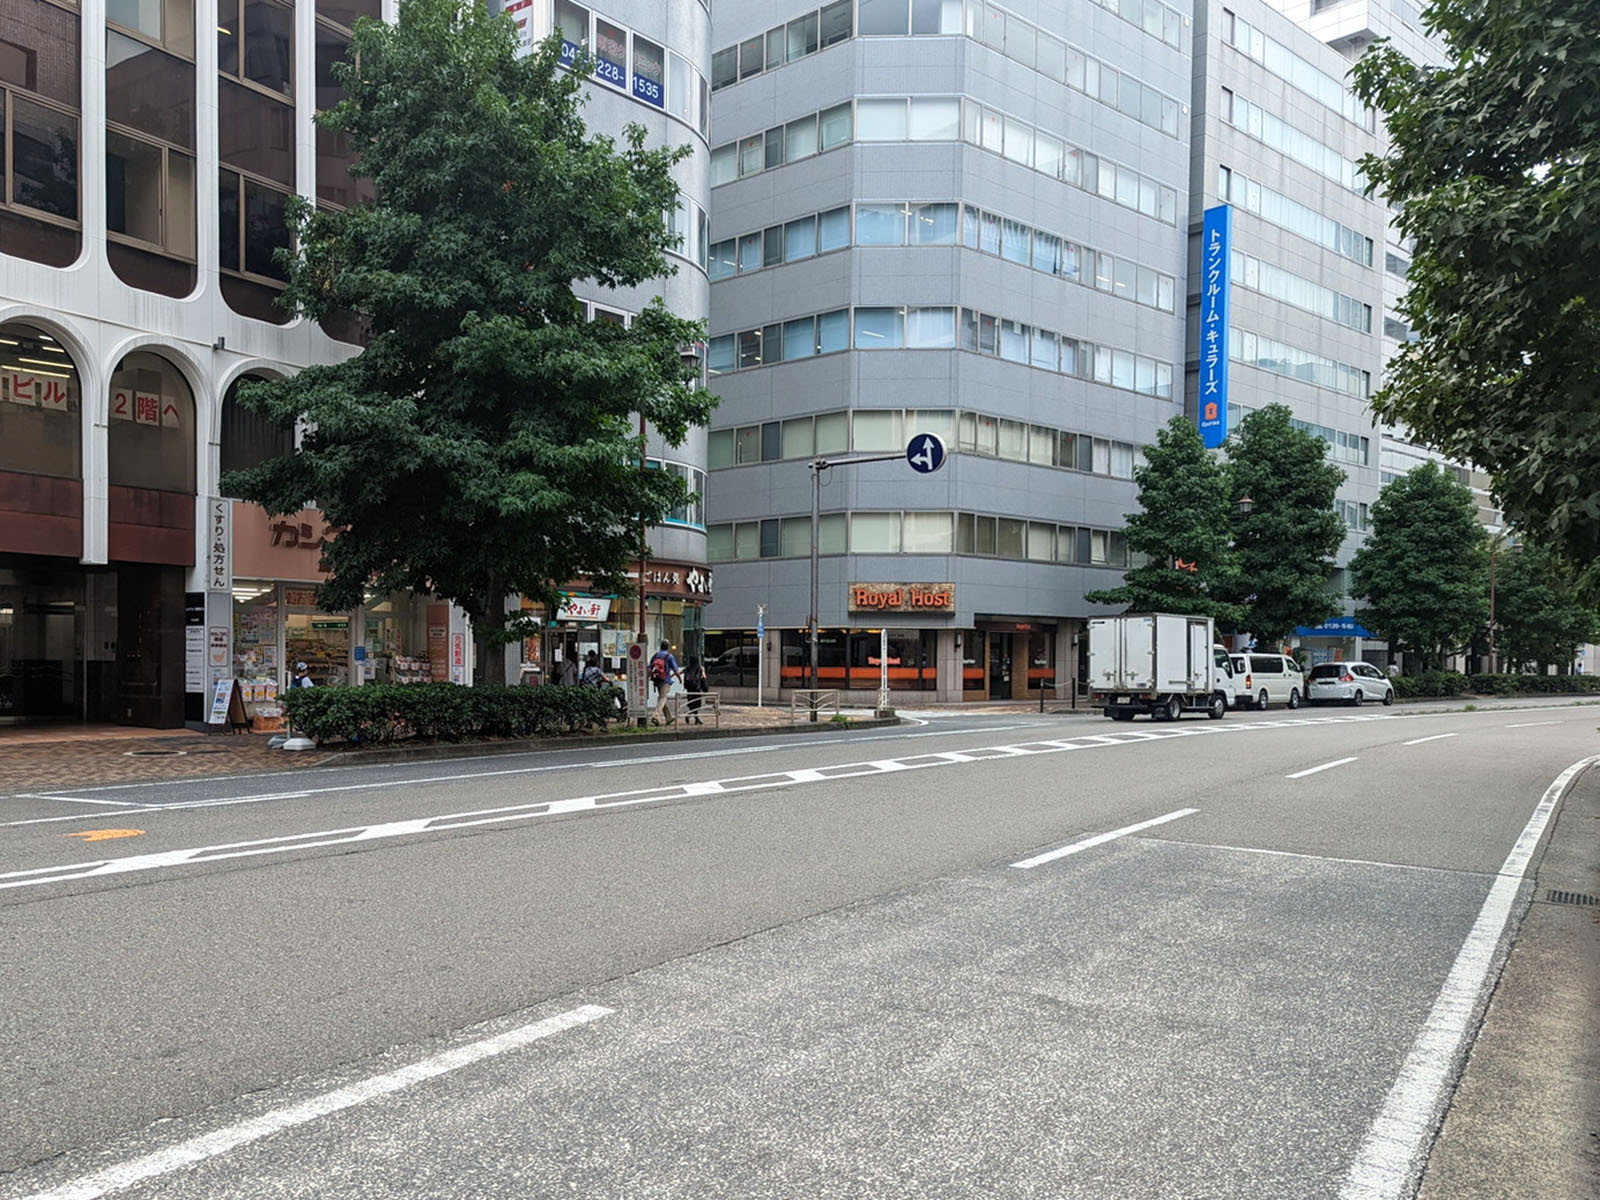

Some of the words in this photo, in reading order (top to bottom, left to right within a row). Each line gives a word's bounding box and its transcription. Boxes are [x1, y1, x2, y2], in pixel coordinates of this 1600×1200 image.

[1205, 228, 1221, 395] トランクルーム・キュラーズ
[13, 374, 65, 403] ビル
[115, 393, 181, 424] 2階へ
[213, 503, 225, 587] くすり・処方せん
[855, 588, 904, 608] Royal
[910, 588, 950, 607] Host
